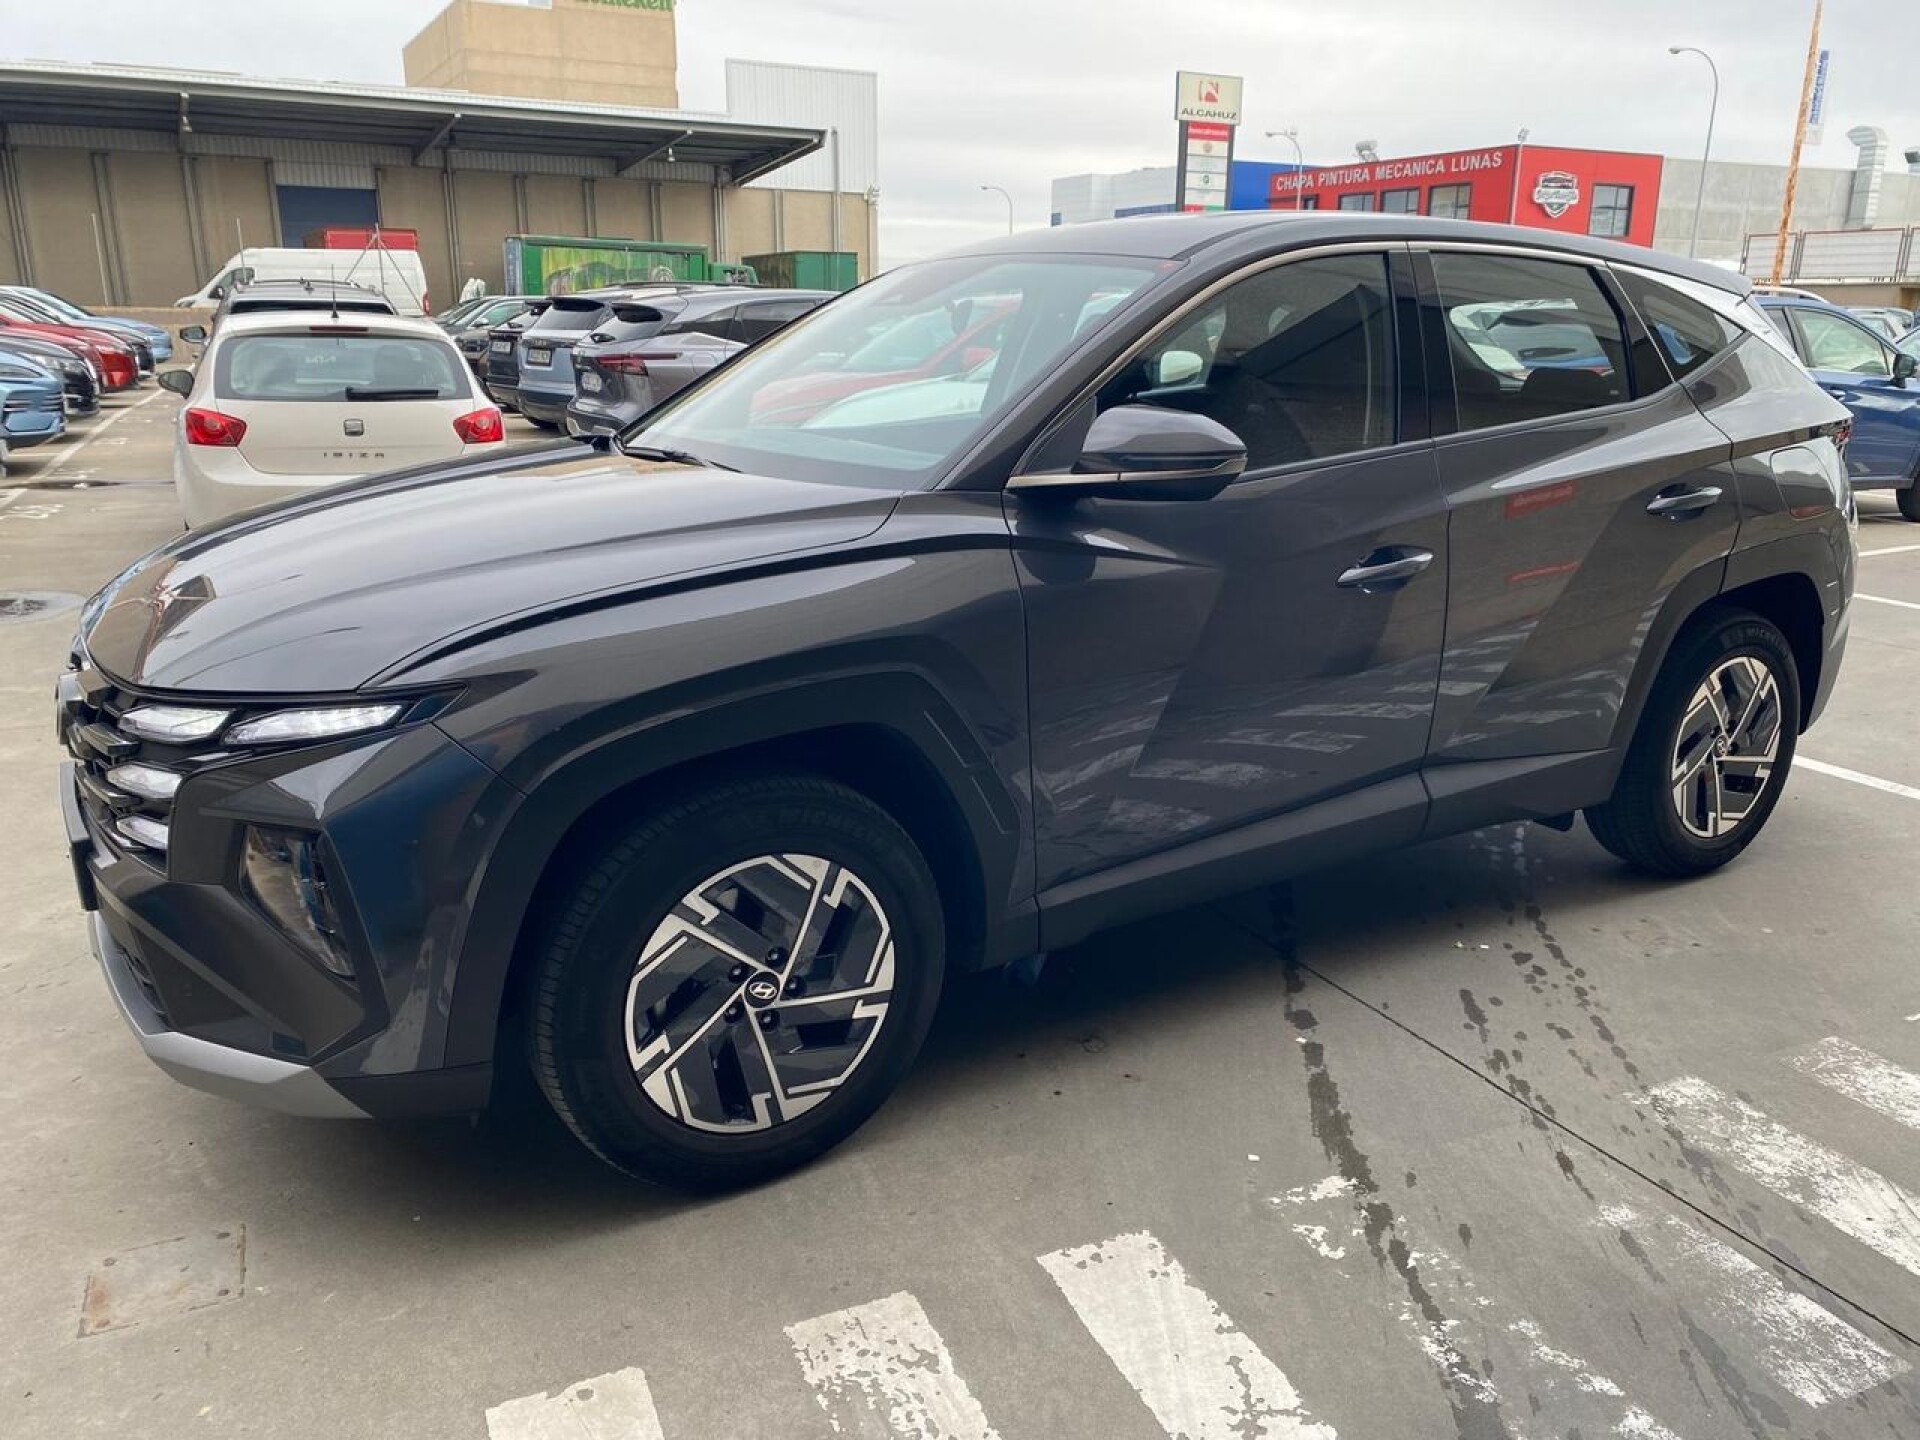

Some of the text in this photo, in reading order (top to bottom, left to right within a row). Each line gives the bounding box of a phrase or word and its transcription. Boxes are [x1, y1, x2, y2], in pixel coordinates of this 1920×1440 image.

[1181, 107, 1237, 119] ALCAHUZ
[1276, 151, 1503, 190] CHAPA PINTURA MECANICA LUNAS
